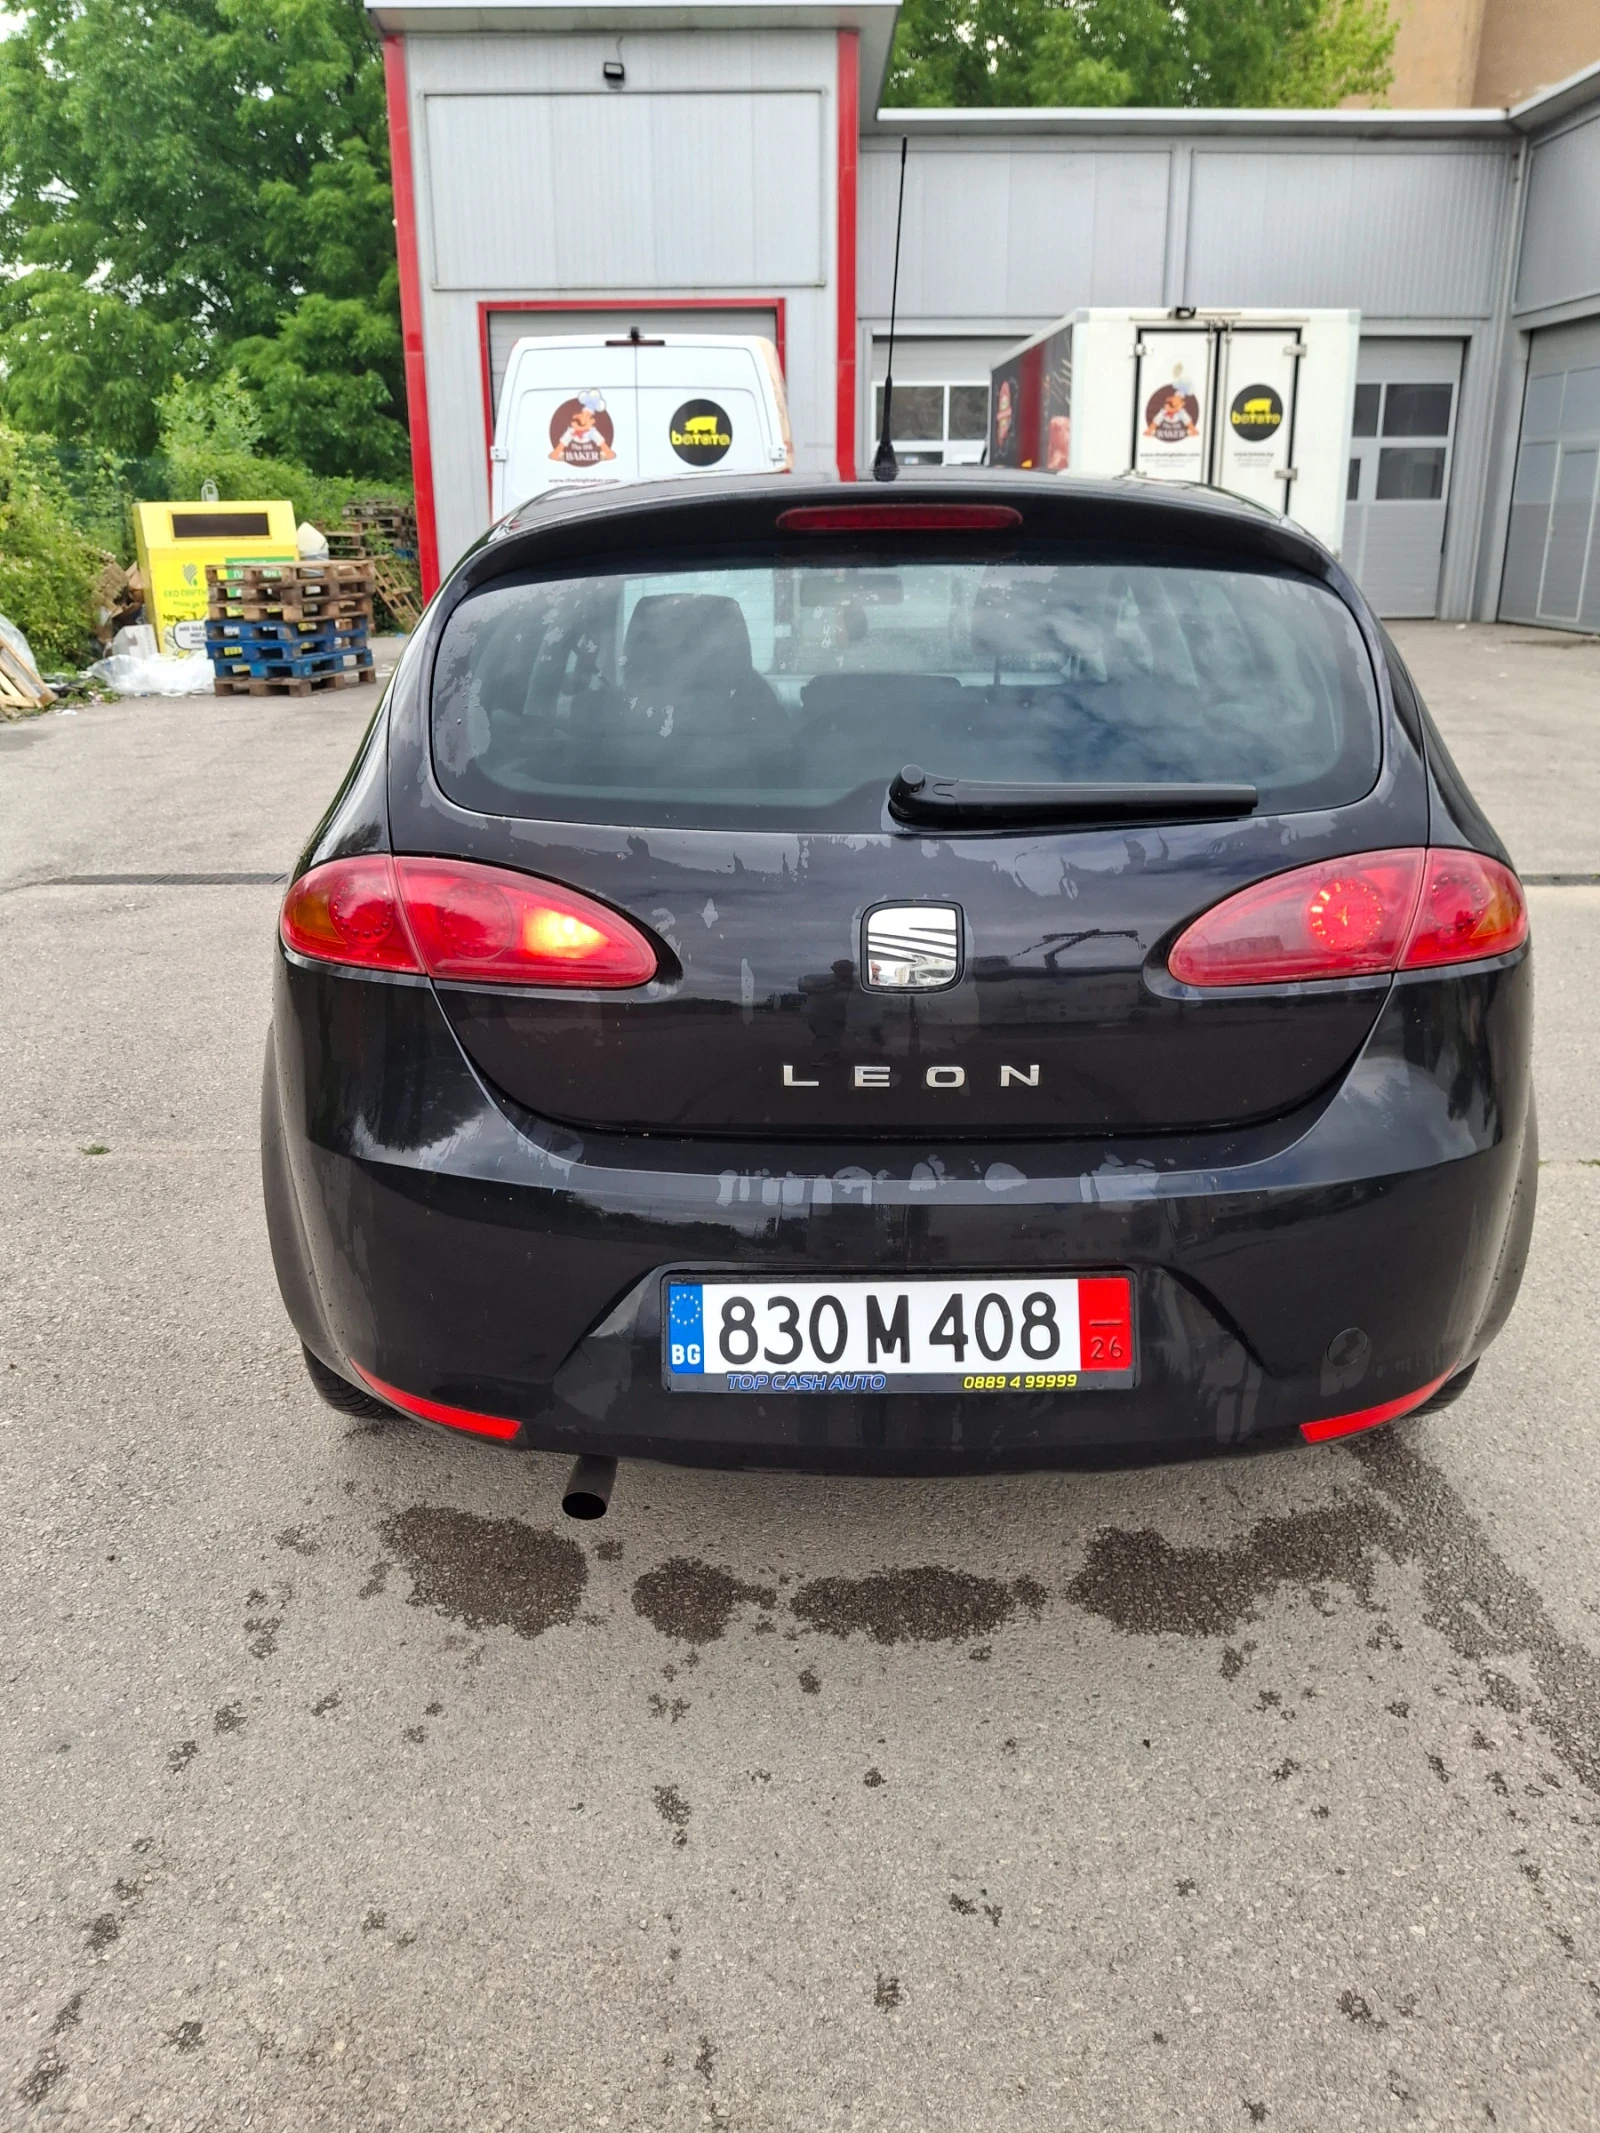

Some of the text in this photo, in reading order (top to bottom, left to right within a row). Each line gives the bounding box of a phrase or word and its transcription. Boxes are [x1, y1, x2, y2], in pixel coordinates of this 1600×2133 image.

[565, 451, 599, 461] BAKER
[783, 1064, 1040, 1088] LEON
[719, 1291, 1061, 1365] 830 M 408
[671, 1343, 702, 1366] BG
[1090, 1335, 1124, 1360] 26
[726, 1373, 887, 1391] TOP CASH AUTO
[963, 1374, 1078, 1390] 0889 4 99999
